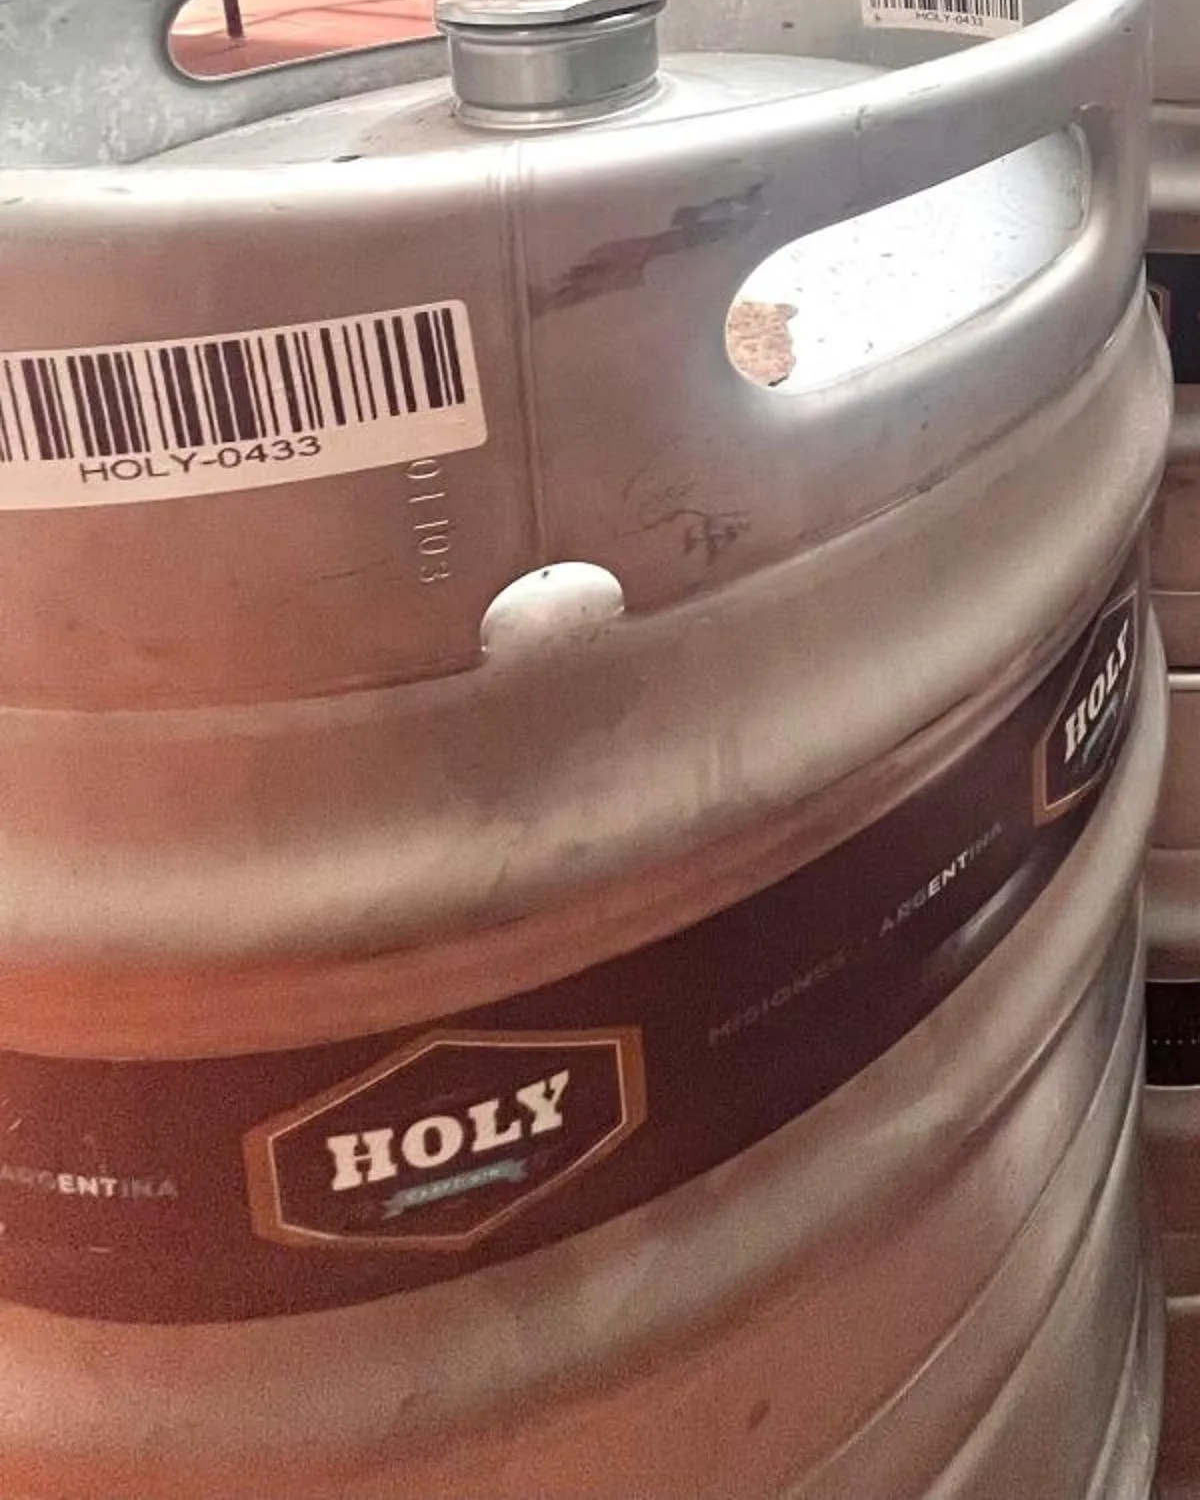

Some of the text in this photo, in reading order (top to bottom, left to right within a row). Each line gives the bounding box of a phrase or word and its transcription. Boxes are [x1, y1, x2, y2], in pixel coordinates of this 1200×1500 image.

[79, 435, 322, 483] HOLY-0433
[1064, 617, 1129, 765] HOLY
[326, 1069, 569, 1192] HOLY
